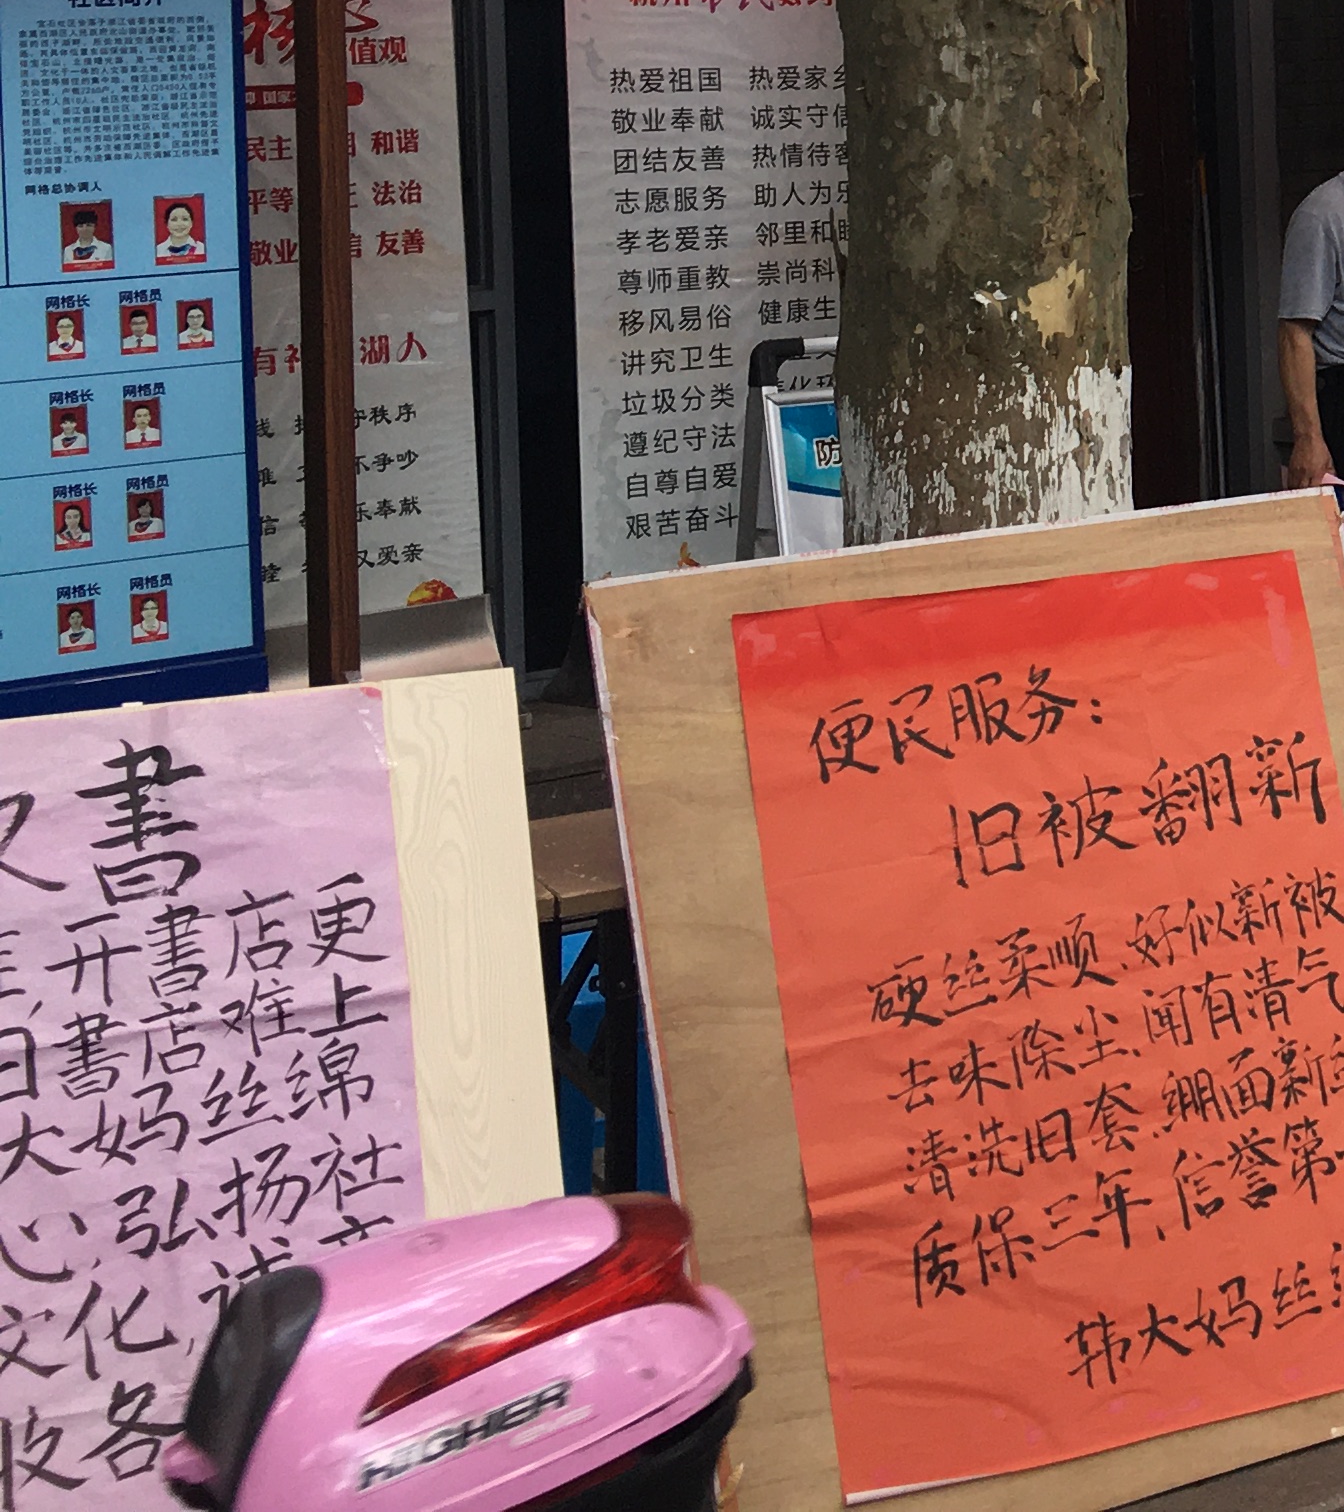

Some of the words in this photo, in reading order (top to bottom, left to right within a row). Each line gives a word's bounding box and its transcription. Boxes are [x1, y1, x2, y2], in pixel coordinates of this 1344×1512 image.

[609, 67, 722, 94] 热爱祖国
[611, 106, 725, 135] 敬业奉献
[246, 135, 294, 163] 民主
[371, 128, 420, 156] 和谐
[613, 145, 726, 175] 团结友善
[248, 187, 294, 215] 平等
[371, 179, 423, 207] 法治
[614, 185, 728, 215] 志愿服务
[250, 239, 299, 267] 敬业
[376, 228, 425, 257] 友善
[616, 224, 729, 256] 孝老爱亲
[617, 264, 731, 295] 尊师重教
[757, 257, 836, 287] 崇尚科
[45, 294, 91, 310] 网格长
[119, 288, 163, 304] 网格员
[619, 304, 732, 336] 移风易俗
[757, 295, 838, 326] 健康生
[620, 344, 734, 377] 讲究卫生
[49, 389, 94, 404] 网格长
[122, 382, 166, 398] 网格员
[622, 383, 735, 417] 垃圾分类
[623, 423, 737, 459] 遵纪守法
[52, 482, 98, 499] 网格长
[126, 474, 169, 491] 网格员
[626, 462, 737, 500] 自尊自爱
[625, 503, 740, 540] 艰苦奋斗
[56, 583, 101, 601] 网格长
[129, 573, 173, 590] 网格员
[949, 729, 1328, 889] 旧被翻新
